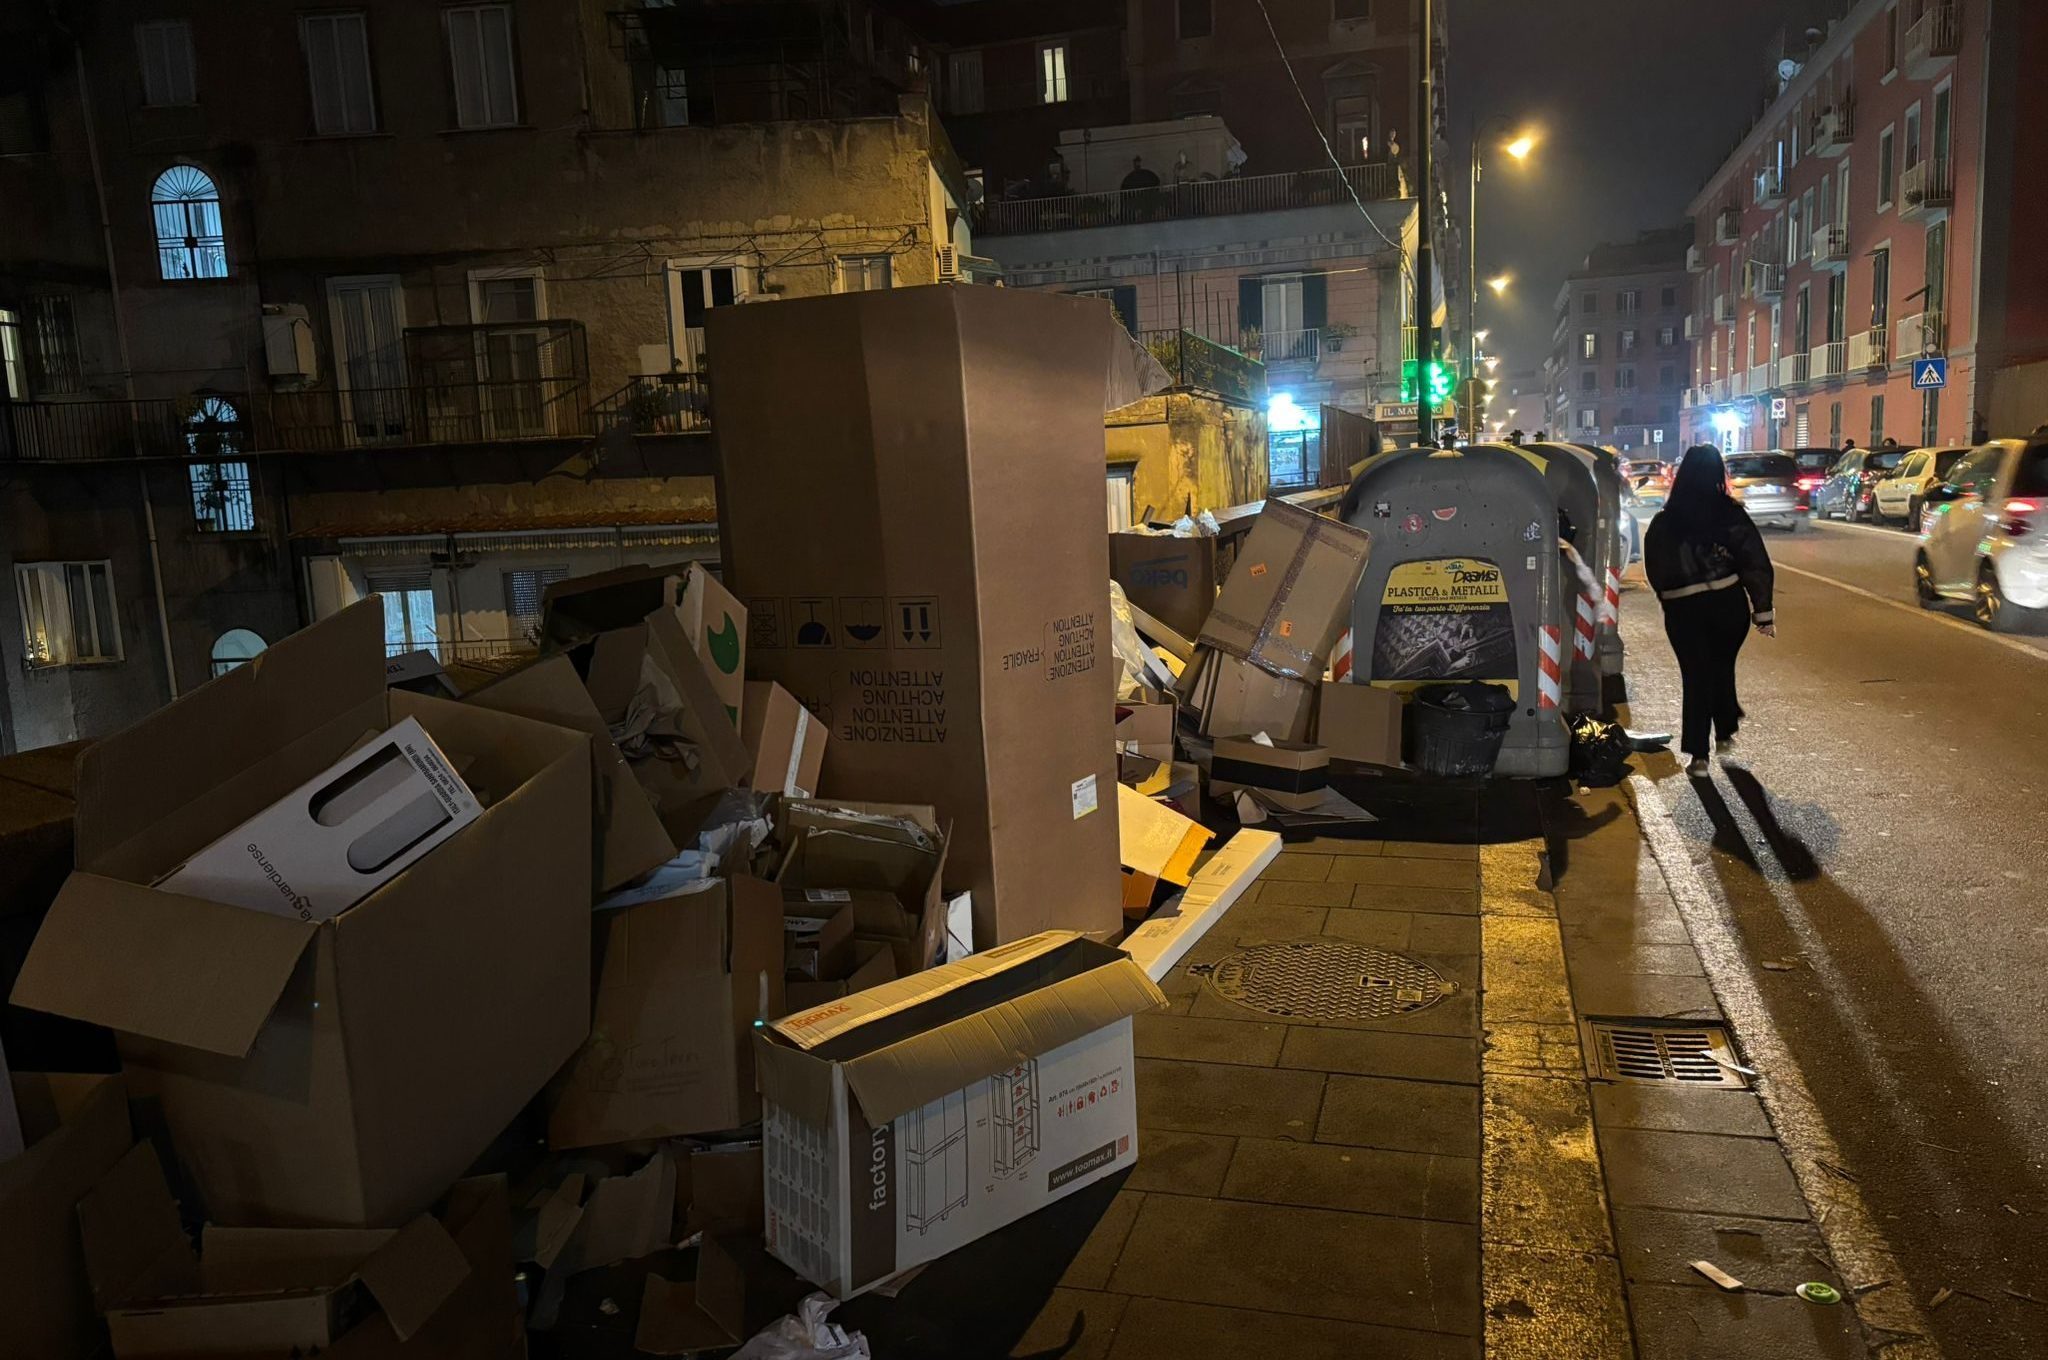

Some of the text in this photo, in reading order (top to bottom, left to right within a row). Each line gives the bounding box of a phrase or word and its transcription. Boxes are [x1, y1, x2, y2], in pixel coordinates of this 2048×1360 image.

[1384, 406, 1442, 416] IL MATNO
[1388, 586, 1439, 597] PLASTICA
[1451, 585, 1499, 596] METALLI
[1053, 612, 1093, 632] ATTENTION
[1059, 627, 1094, 647] ACHTUNG
[1003, 648, 1039, 670] FRAGILE
[1054, 642, 1094, 663] ATTENTION
[1050, 656, 1095, 680] ATTENZIONE
[850, 671, 943, 686] ATTENTION
[863, 690, 944, 705] ACHTUNG
[853, 708, 945, 723] ATTENTION
[843, 726, 947, 742] ATTENZIONE
[869, 1125, 889, 1211] factory
[1053, 1148, 1112, 1184] www.toomax.it
